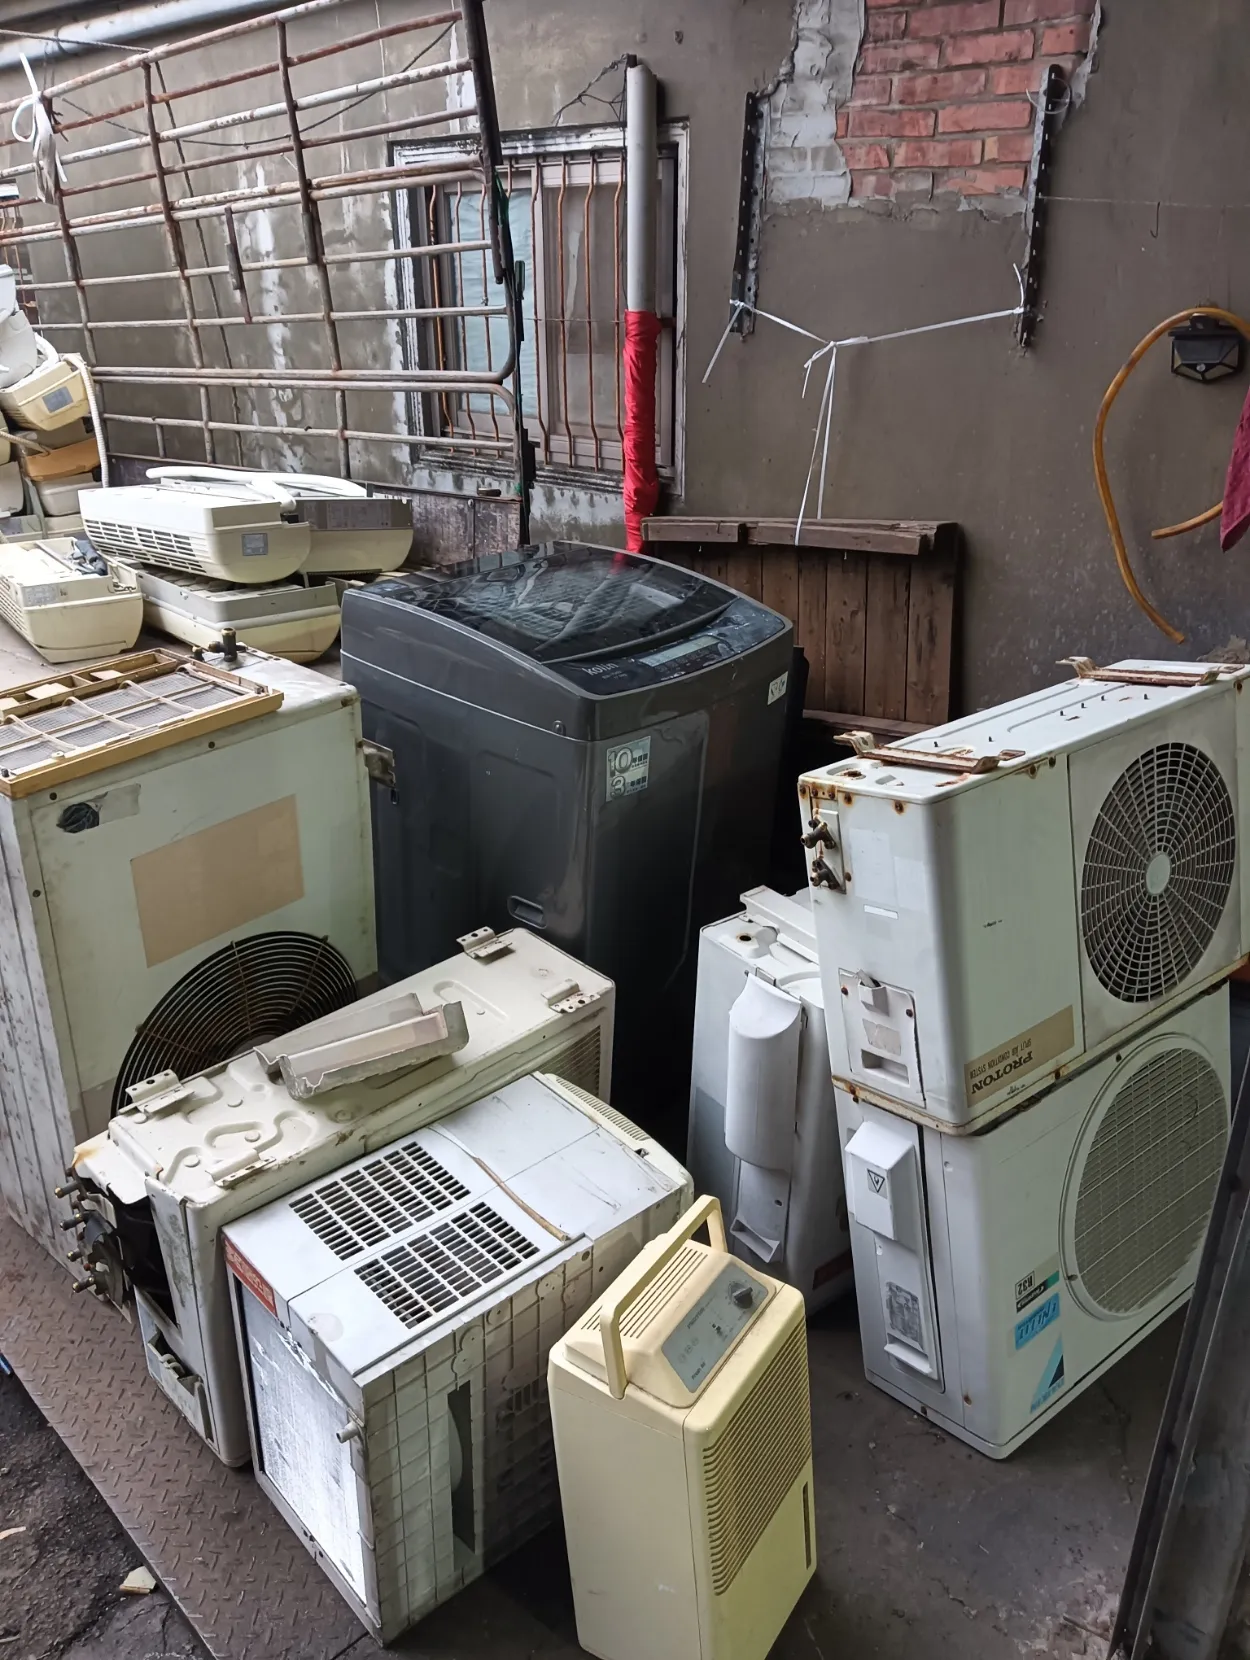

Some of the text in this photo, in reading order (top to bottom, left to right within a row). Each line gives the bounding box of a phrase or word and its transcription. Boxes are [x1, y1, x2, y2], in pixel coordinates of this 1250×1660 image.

[581, 662, 619, 677] kolin
[607, 747, 633, 778] 10
[610, 775, 627, 799] 3
[971, 1051, 1033, 1094] PROTON
[1017, 1274, 1034, 1296] R32
